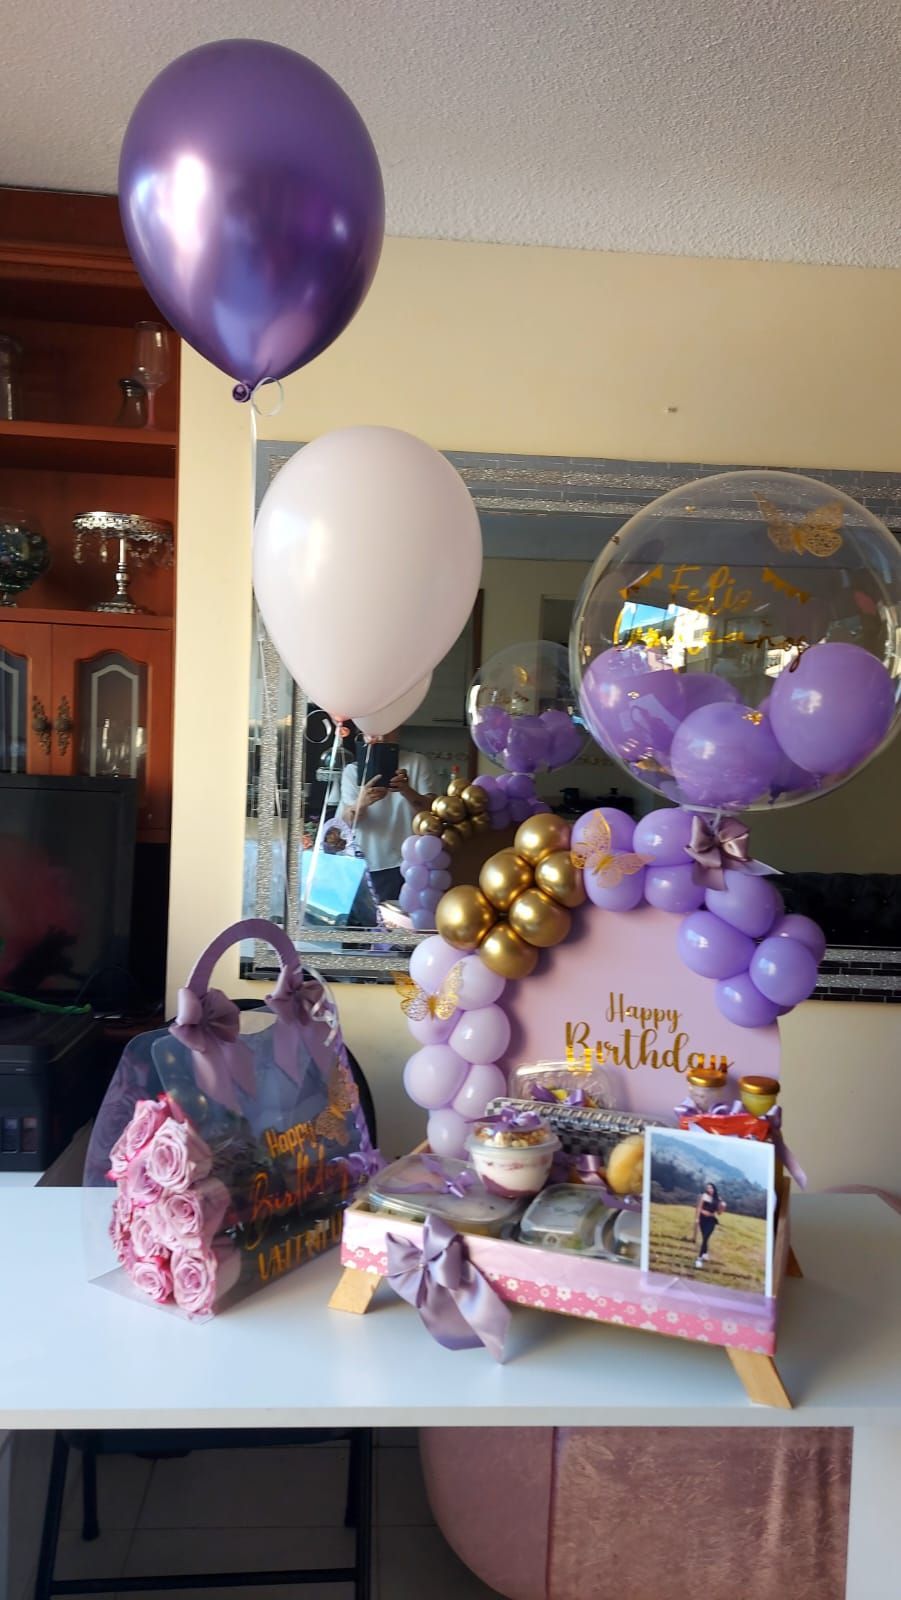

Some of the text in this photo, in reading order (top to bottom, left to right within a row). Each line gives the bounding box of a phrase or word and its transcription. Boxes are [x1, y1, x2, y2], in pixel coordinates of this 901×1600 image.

[605, 991, 683, 1033] Happy
[565, 1021, 735, 1073] Birthday
[264, 1120, 319, 1159] Happy
